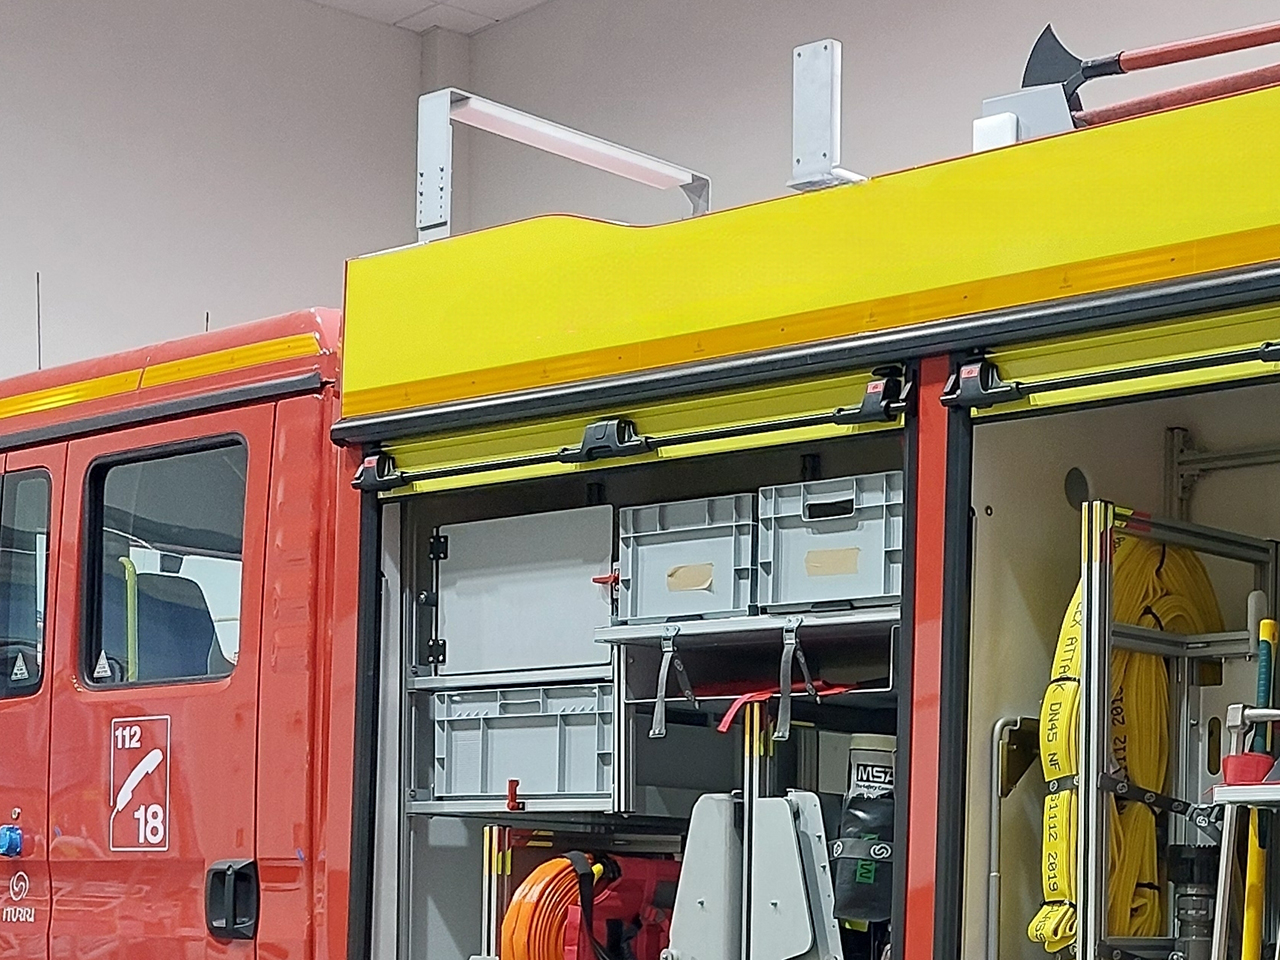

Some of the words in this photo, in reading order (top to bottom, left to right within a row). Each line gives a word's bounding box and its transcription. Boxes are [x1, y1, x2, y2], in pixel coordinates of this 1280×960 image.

[114, 726, 142, 749] 112
[1046, 702, 1062, 743] DN45
[1047, 752, 1060, 772] NF
[134, 803, 165, 844] 18
[1047, 852, 1059, 893] 2019
